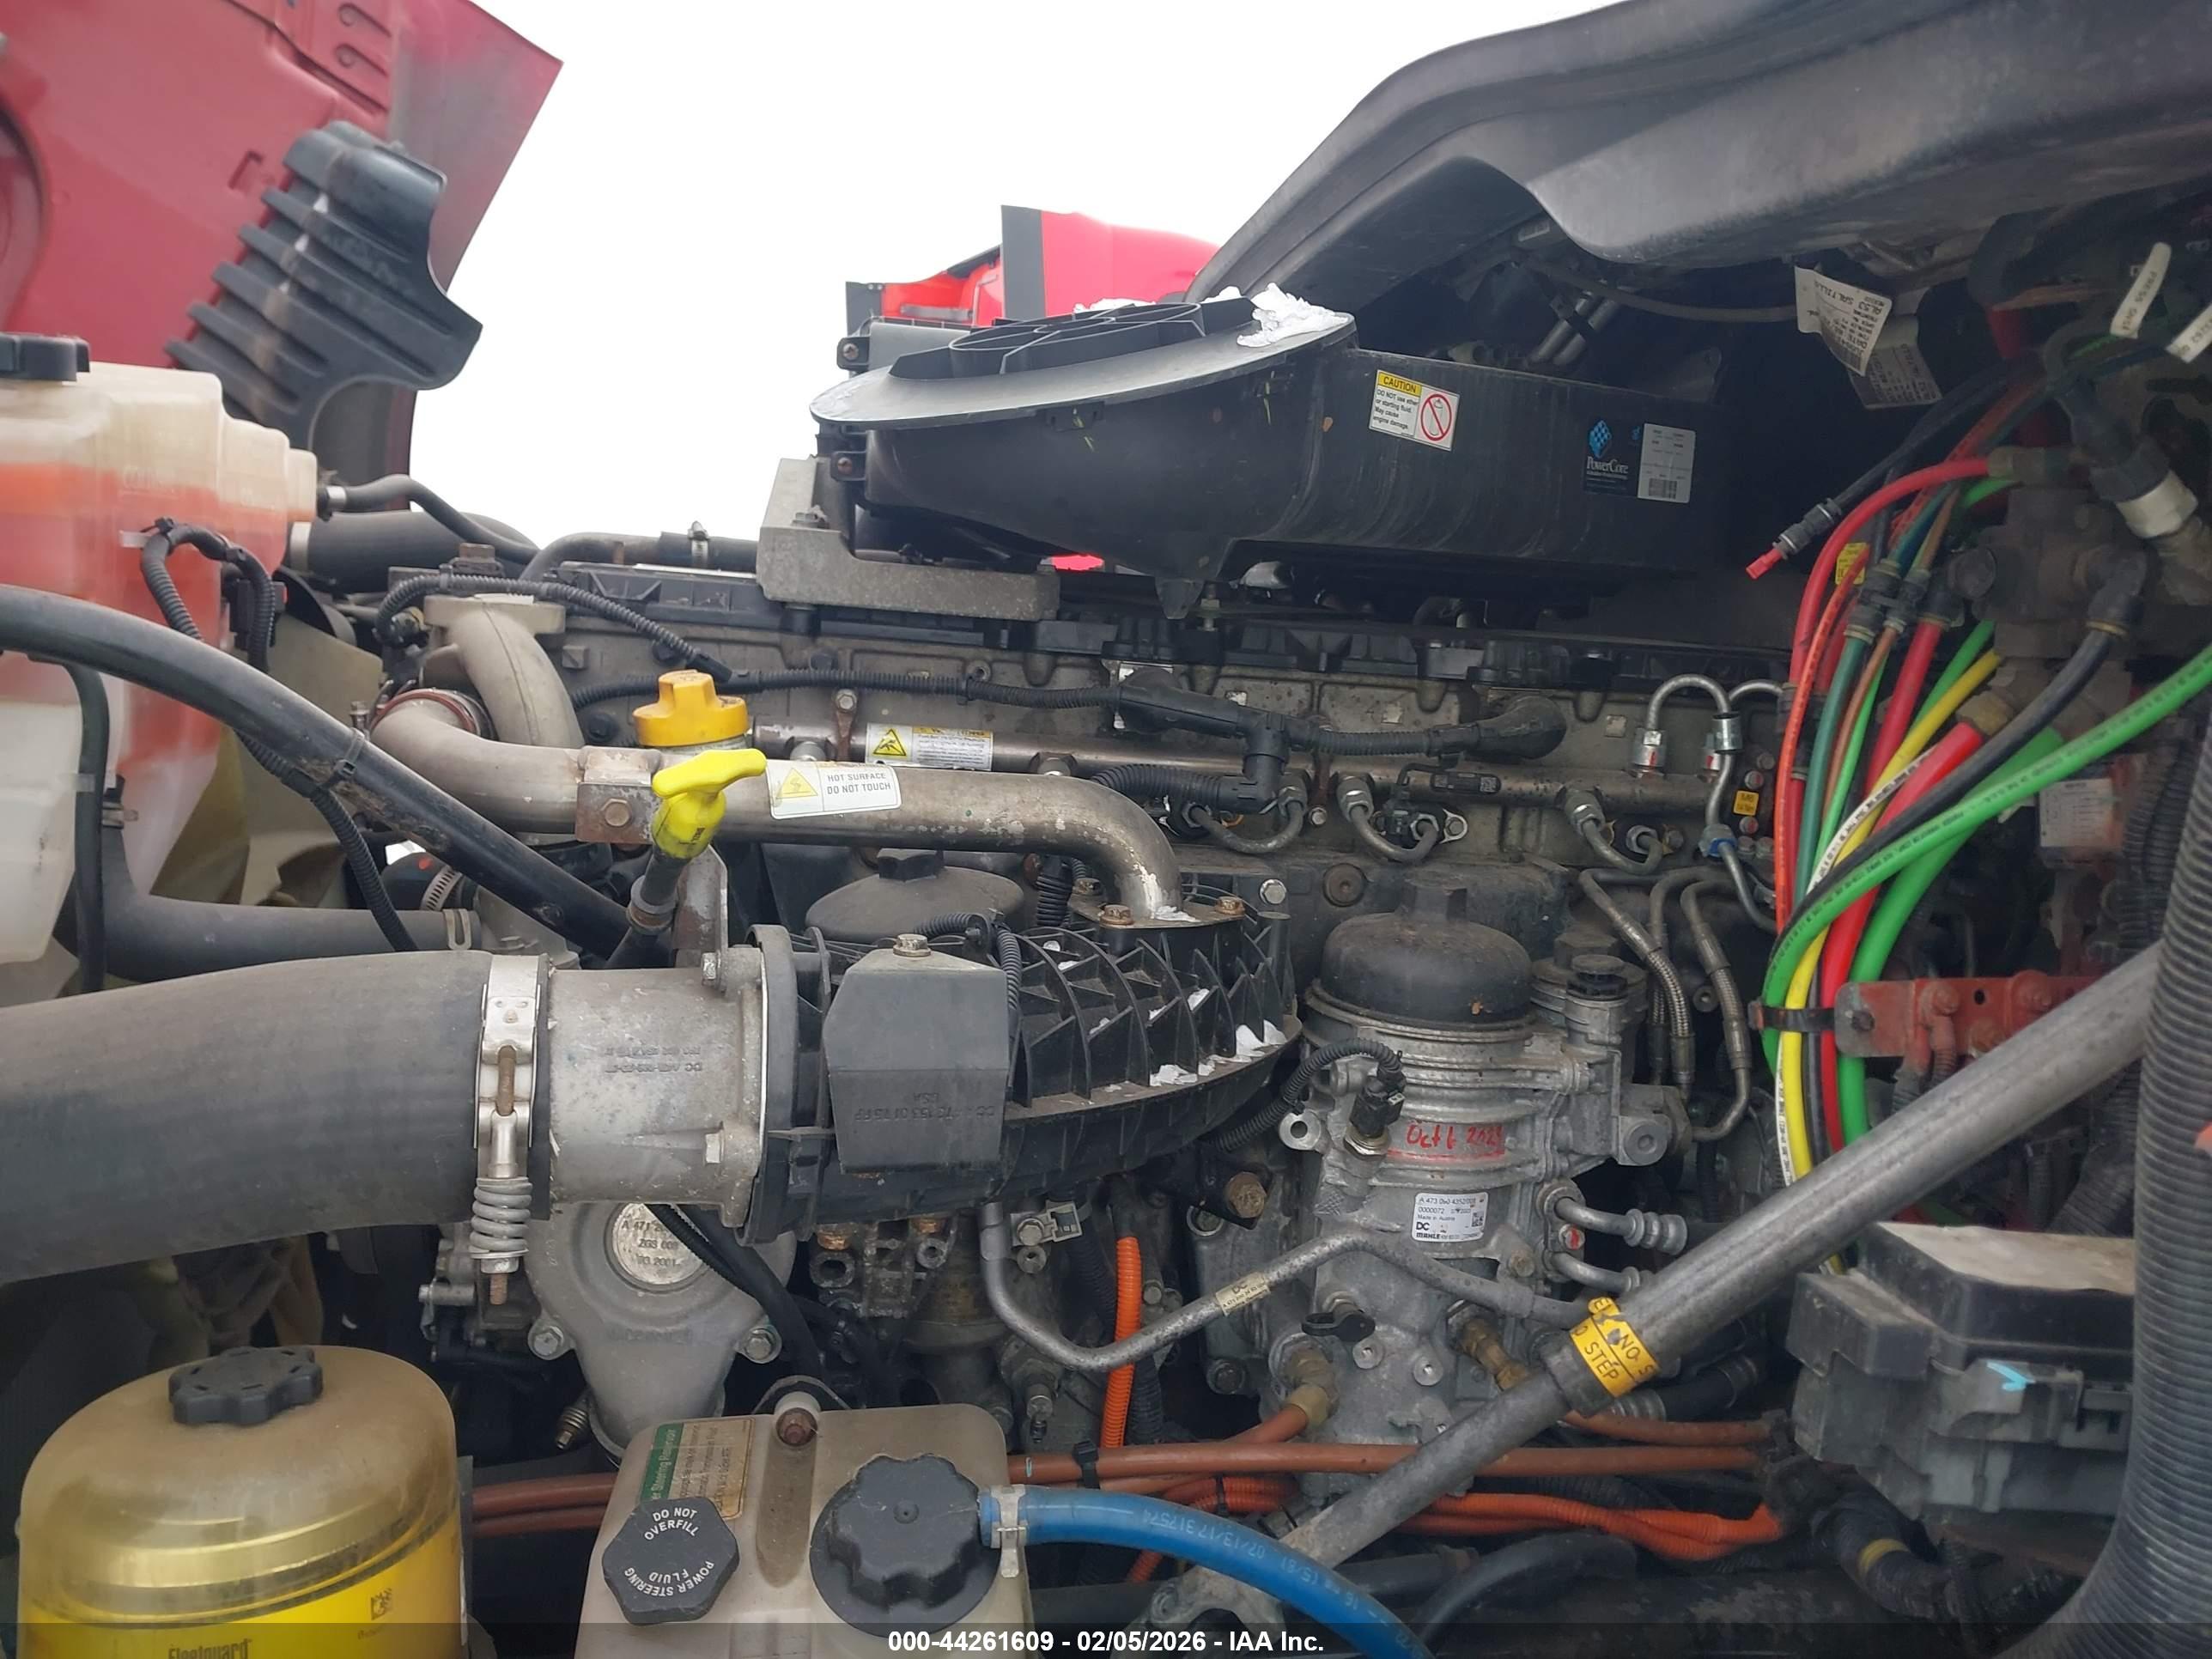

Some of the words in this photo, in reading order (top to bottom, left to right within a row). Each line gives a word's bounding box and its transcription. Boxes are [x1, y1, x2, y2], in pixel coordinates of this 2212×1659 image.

[1382, 375, 1418, 393] CAUTION
[1376, 389, 1386, 398] DO
[1386, 392, 1397, 400] NOT
[1375, 406, 1384, 416] May
[1382, 400, 1401, 411] starting
[1373, 416, 1389, 424] engine
[1586, 455, 1629, 474] PowerCore
[827, 774, 845, 782] HOT
[848, 772, 887, 781] SURFACE
[827, 786, 840, 795] DO
[842, 784, 860, 794] NOT
[862, 782, 891, 792] TOUCH
[1415, 1221, 1431, 1231] DC
[1620, 1334, 1642, 1362] NO
[1584, 1341, 1620, 1380] STEP
[652, 1509, 670, 1522] DO
[673, 1507, 698, 1520] NOT
[644, 1519, 700, 1541] OVERFILL
[624, 1566, 674, 1597] STEERING
[648, 1568, 690, 1584] FLUID
[678, 1560, 715, 1594] POWER
